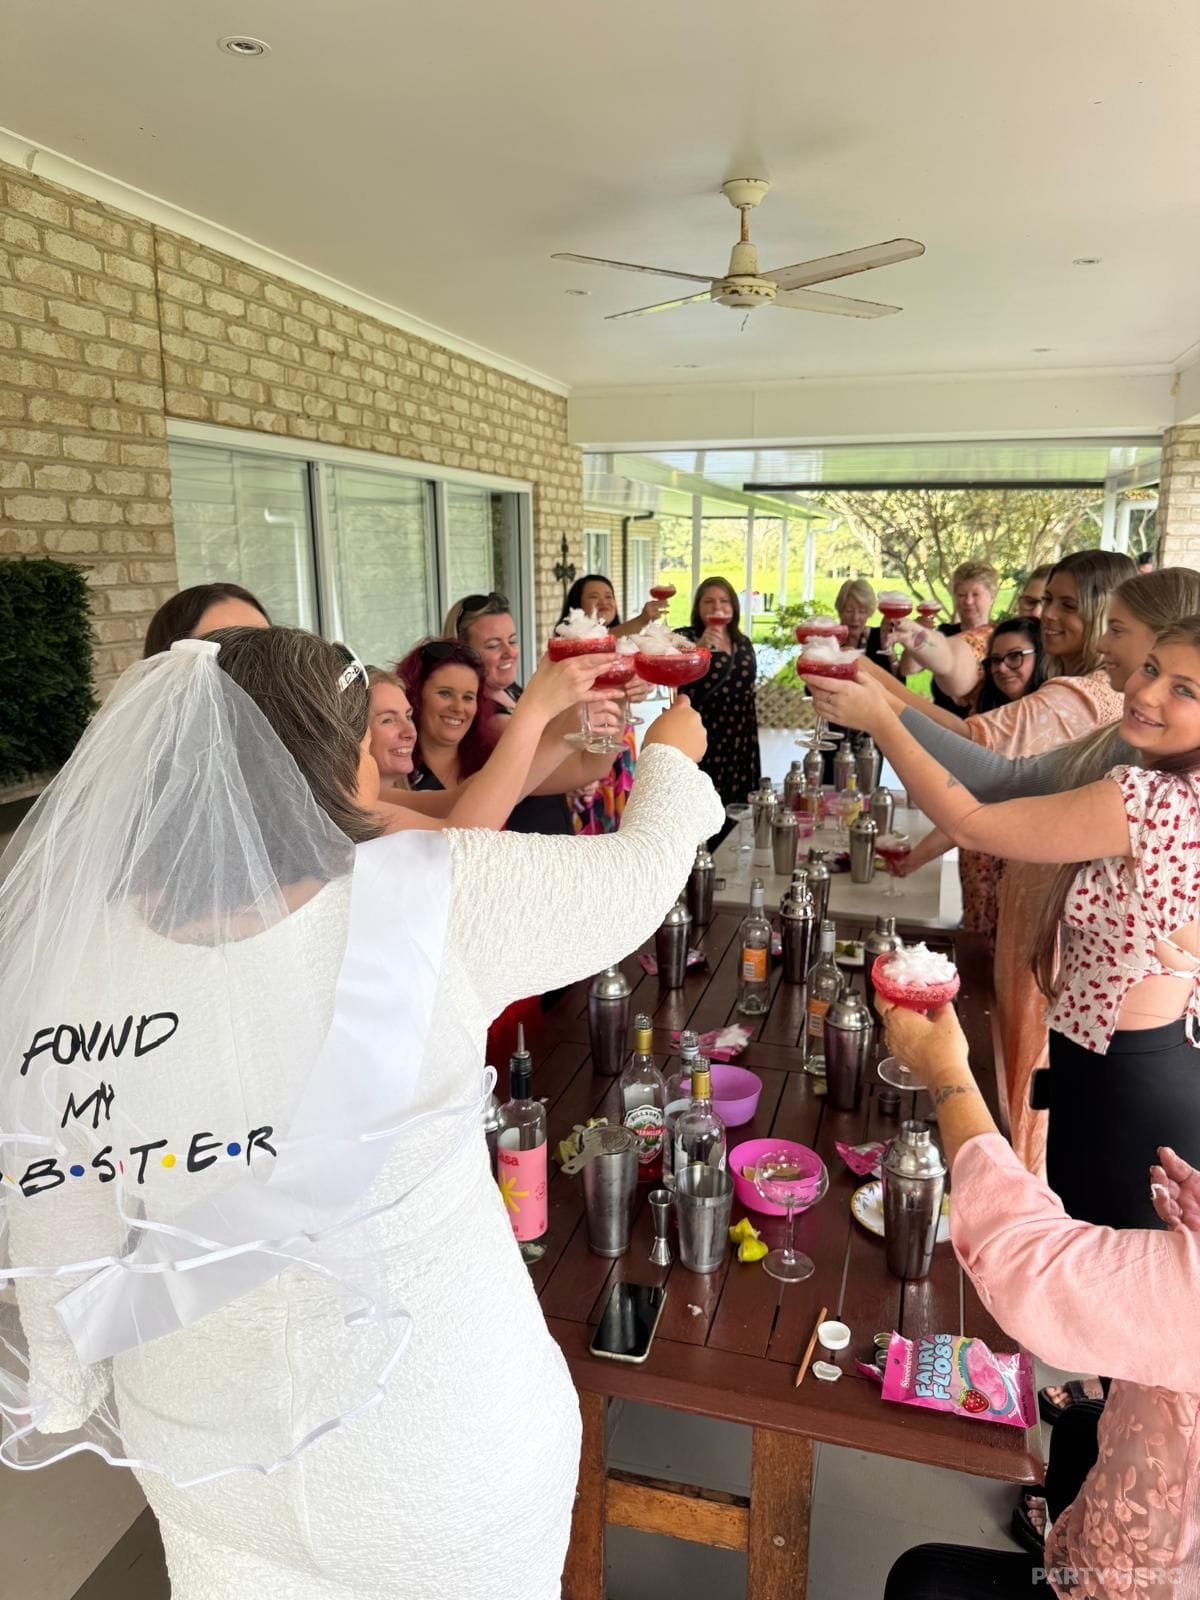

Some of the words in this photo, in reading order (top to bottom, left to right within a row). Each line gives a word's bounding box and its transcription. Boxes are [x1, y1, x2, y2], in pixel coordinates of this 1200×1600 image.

[20, 1011, 179, 1076] FOUND
[61, 1081, 115, 1129] MY
[915, 1340, 935, 1397] FAIRY
[933, 1334, 953, 1400] FLOSS
